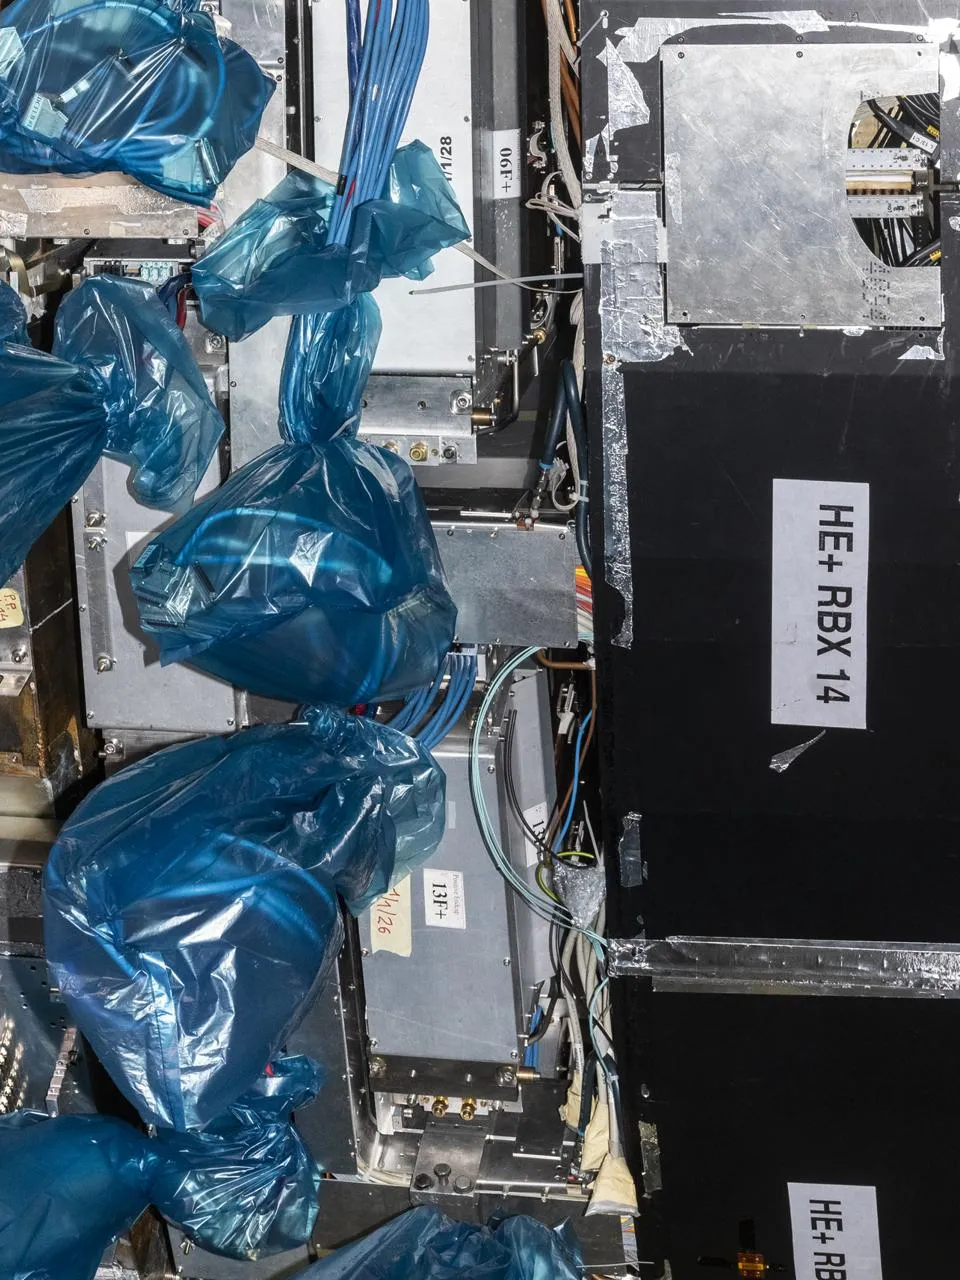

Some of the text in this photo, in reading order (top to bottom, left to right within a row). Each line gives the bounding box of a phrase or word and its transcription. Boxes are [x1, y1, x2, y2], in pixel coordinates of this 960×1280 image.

[440, 136, 453, 181] /1/28
[500, 147, 513, 193] 06F+
[816, 504, 854, 704] HE+ RBX 14
[432, 882, 448, 920] 13F+
[809, 1199, 847, 1280] HE+ RB
